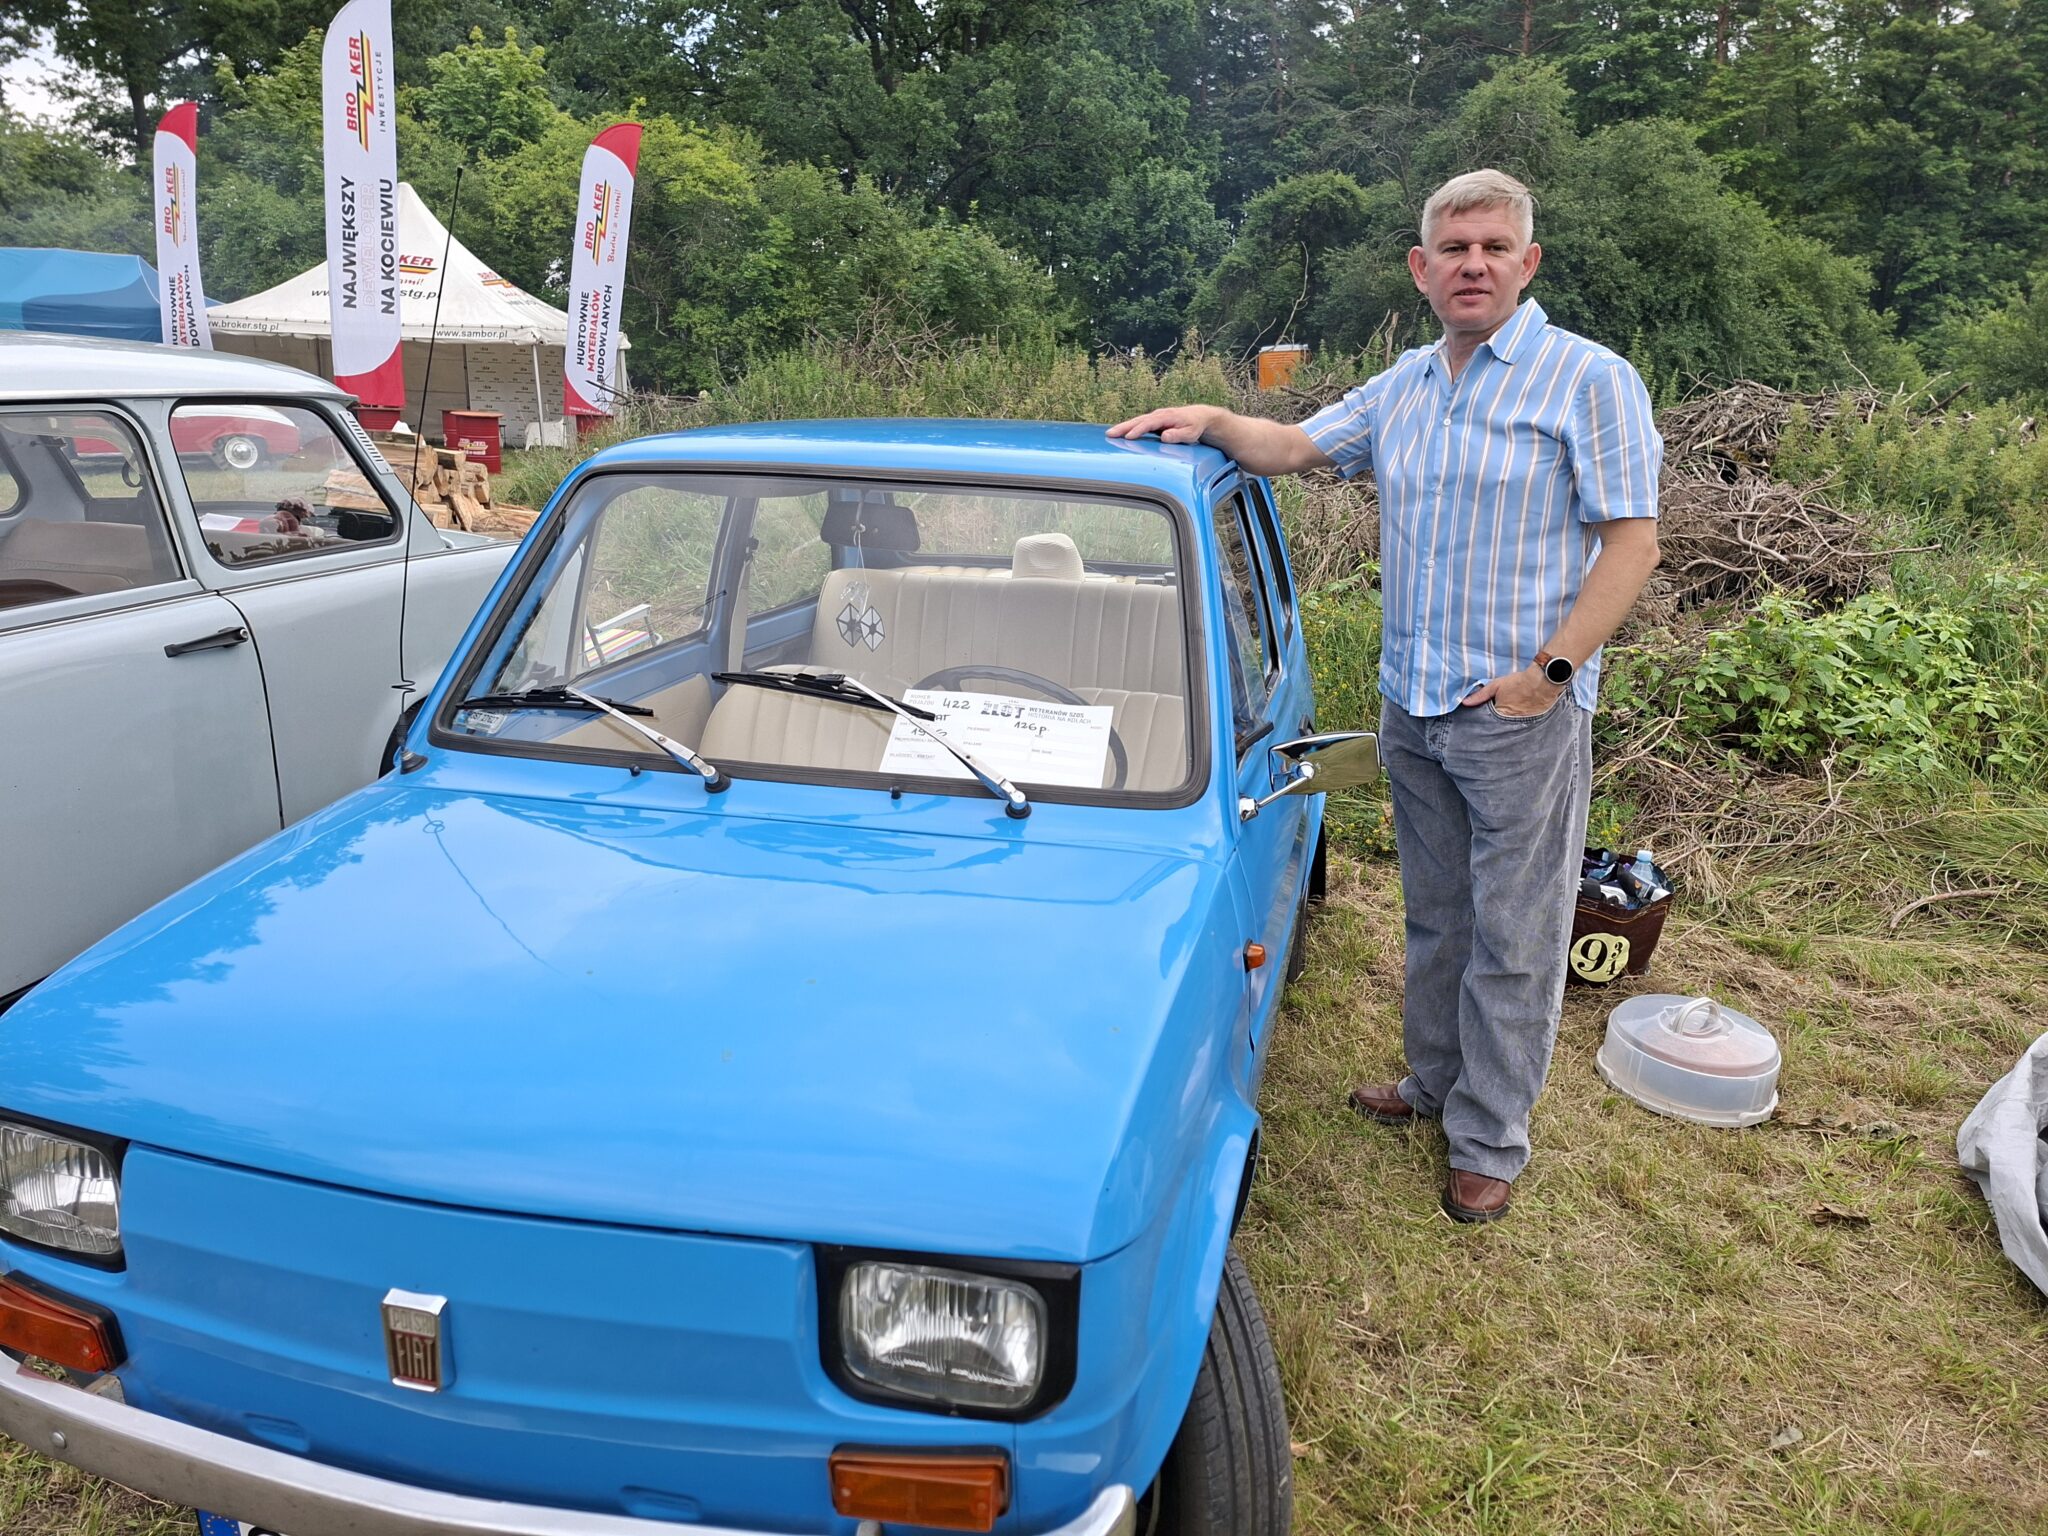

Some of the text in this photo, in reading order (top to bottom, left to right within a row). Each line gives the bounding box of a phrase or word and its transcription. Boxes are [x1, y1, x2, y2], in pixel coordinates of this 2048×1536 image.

[375, 51, 386, 132] INWESTYCJE
[341, 176, 358, 309] NAJWIĘKSZY
[361, 183, 375, 307] DEWELOPER
[379, 179, 395, 314] NA KOCIEWIU
[177, 272, 187, 345] ATERIAŁÓW
[184, 265, 200, 346] DOWLANYCH
[436, 330, 508, 339] www.sambor.pl
[577, 291, 589, 365] HURTOWNIE
[586, 289, 600, 372] MATERIAŁÓW
[597, 284, 612, 382] BUDOWLANYCH
[943, 697, 971, 710] 422
[396, 1334, 433, 1380] FIAT
